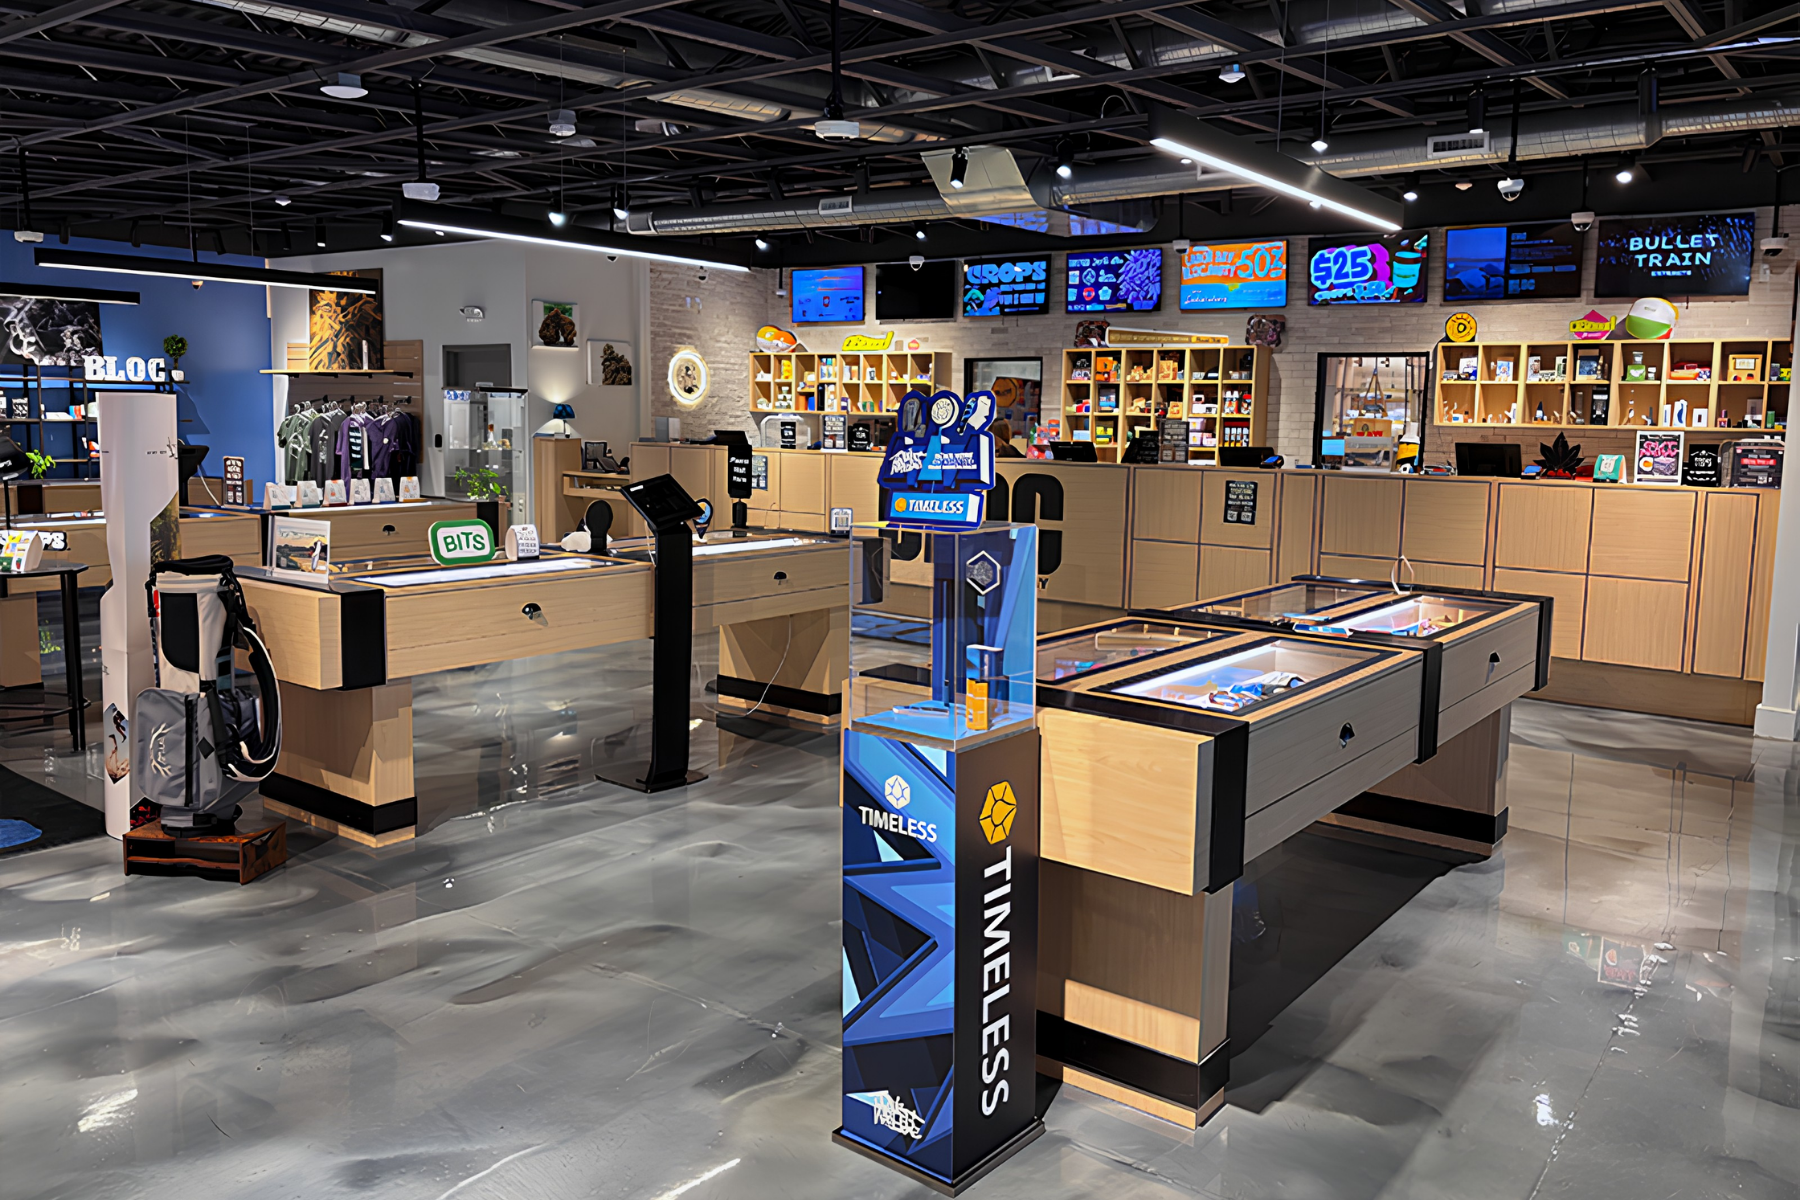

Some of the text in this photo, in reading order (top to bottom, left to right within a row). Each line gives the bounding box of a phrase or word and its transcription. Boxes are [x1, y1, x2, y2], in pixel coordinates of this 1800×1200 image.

[1629, 234, 1719, 251] BULLET
[1311, 246, 1373, 289] $25
[1634, 252, 1712, 268] TRAIN
[81, 355, 166, 382] BLOC
[909, 499, 964, 514] TIMELESS
[443, 532, 485, 552] BITS
[859, 806, 937, 842] TIMELESS
[982, 846, 1011, 1116] TIMELESS
